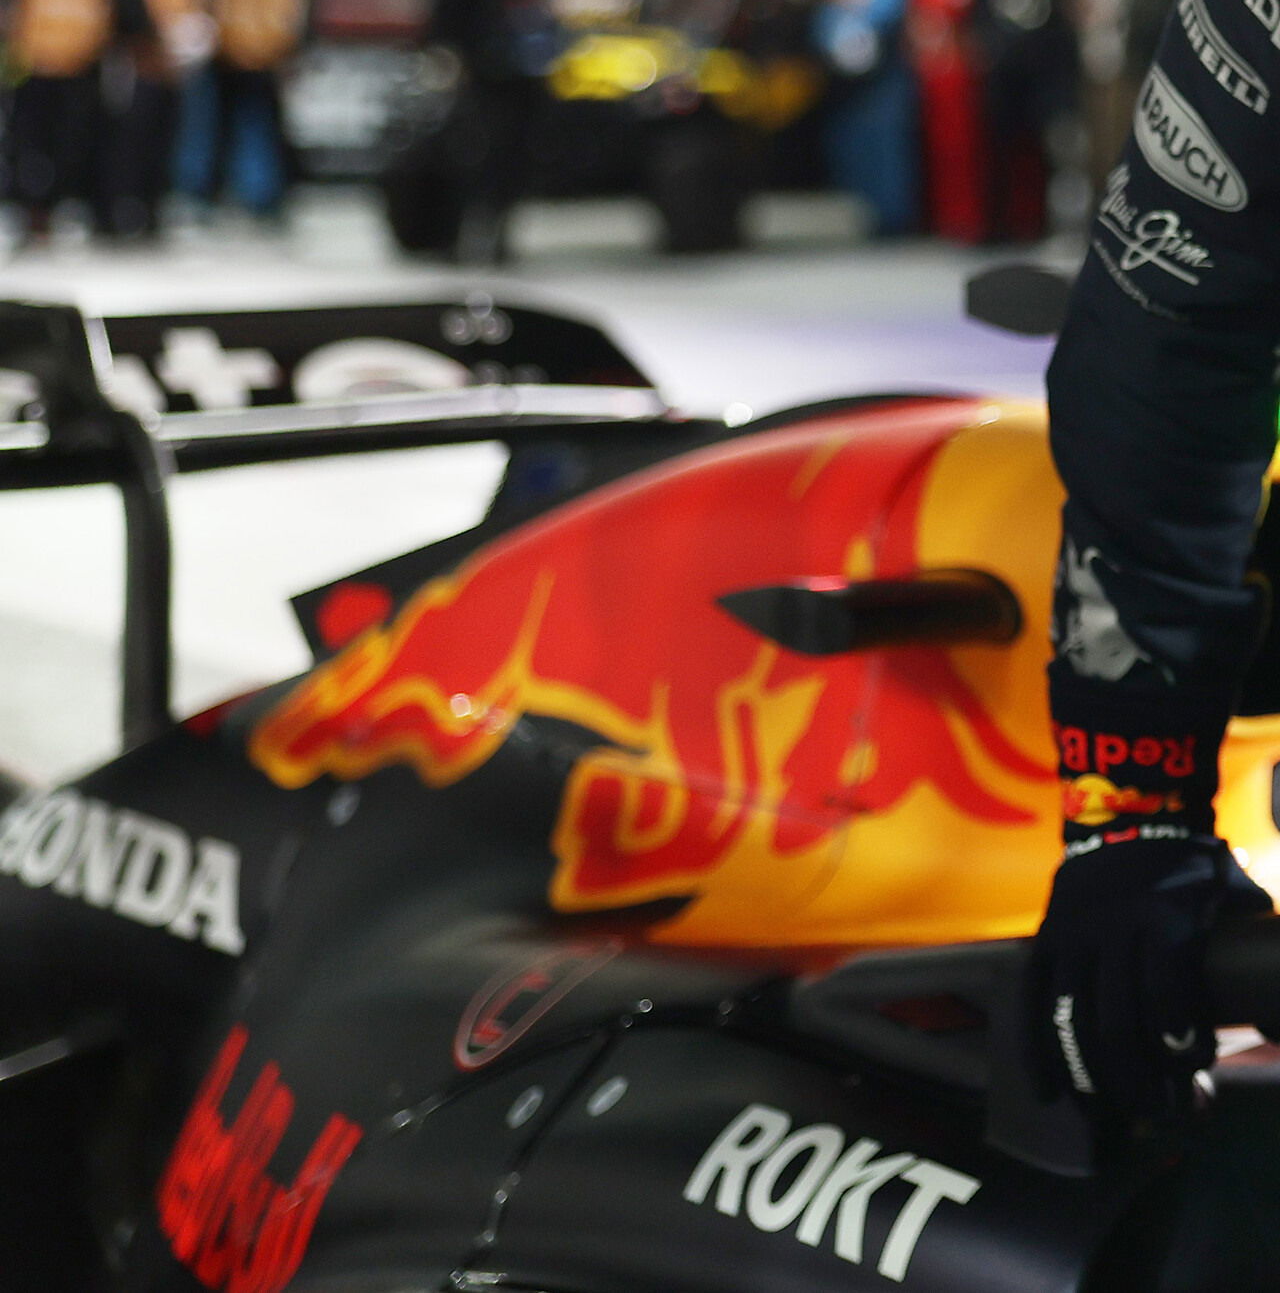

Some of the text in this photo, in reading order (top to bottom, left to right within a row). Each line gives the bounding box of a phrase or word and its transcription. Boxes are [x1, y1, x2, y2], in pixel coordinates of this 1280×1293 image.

[1146, 96, 1229, 197] RAUCH
[1095, 733, 1197, 778] Red
[682, 1103, 983, 1283] ROKT
